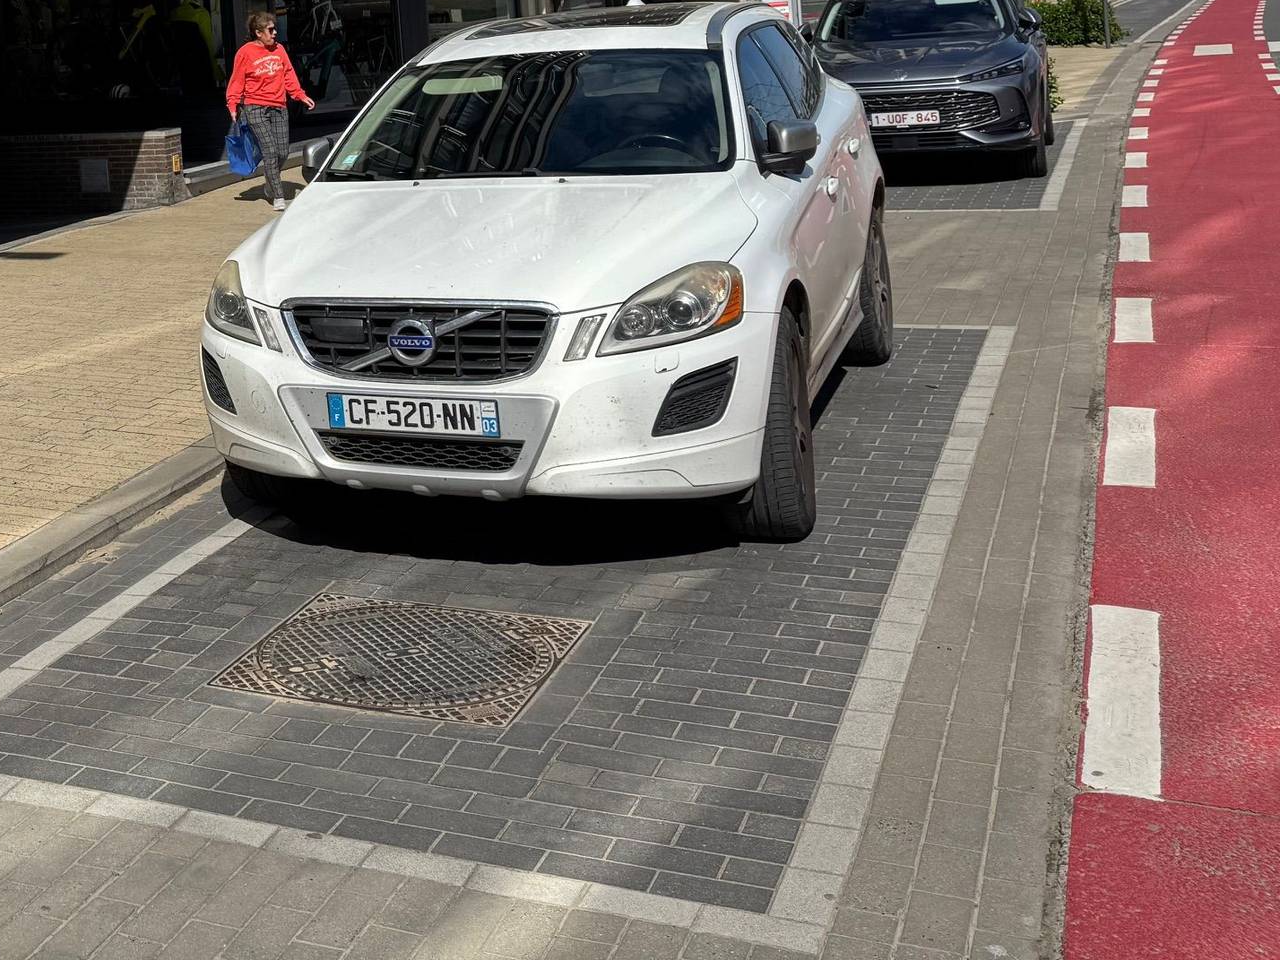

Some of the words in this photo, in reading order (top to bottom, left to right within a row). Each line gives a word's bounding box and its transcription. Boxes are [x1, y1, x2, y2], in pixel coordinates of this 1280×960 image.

[391, 338, 431, 347] VOLVO
[334, 413, 340, 422] F
[348, 398, 476, 431] CF-520-NN
[482, 419, 497, 432] 03
